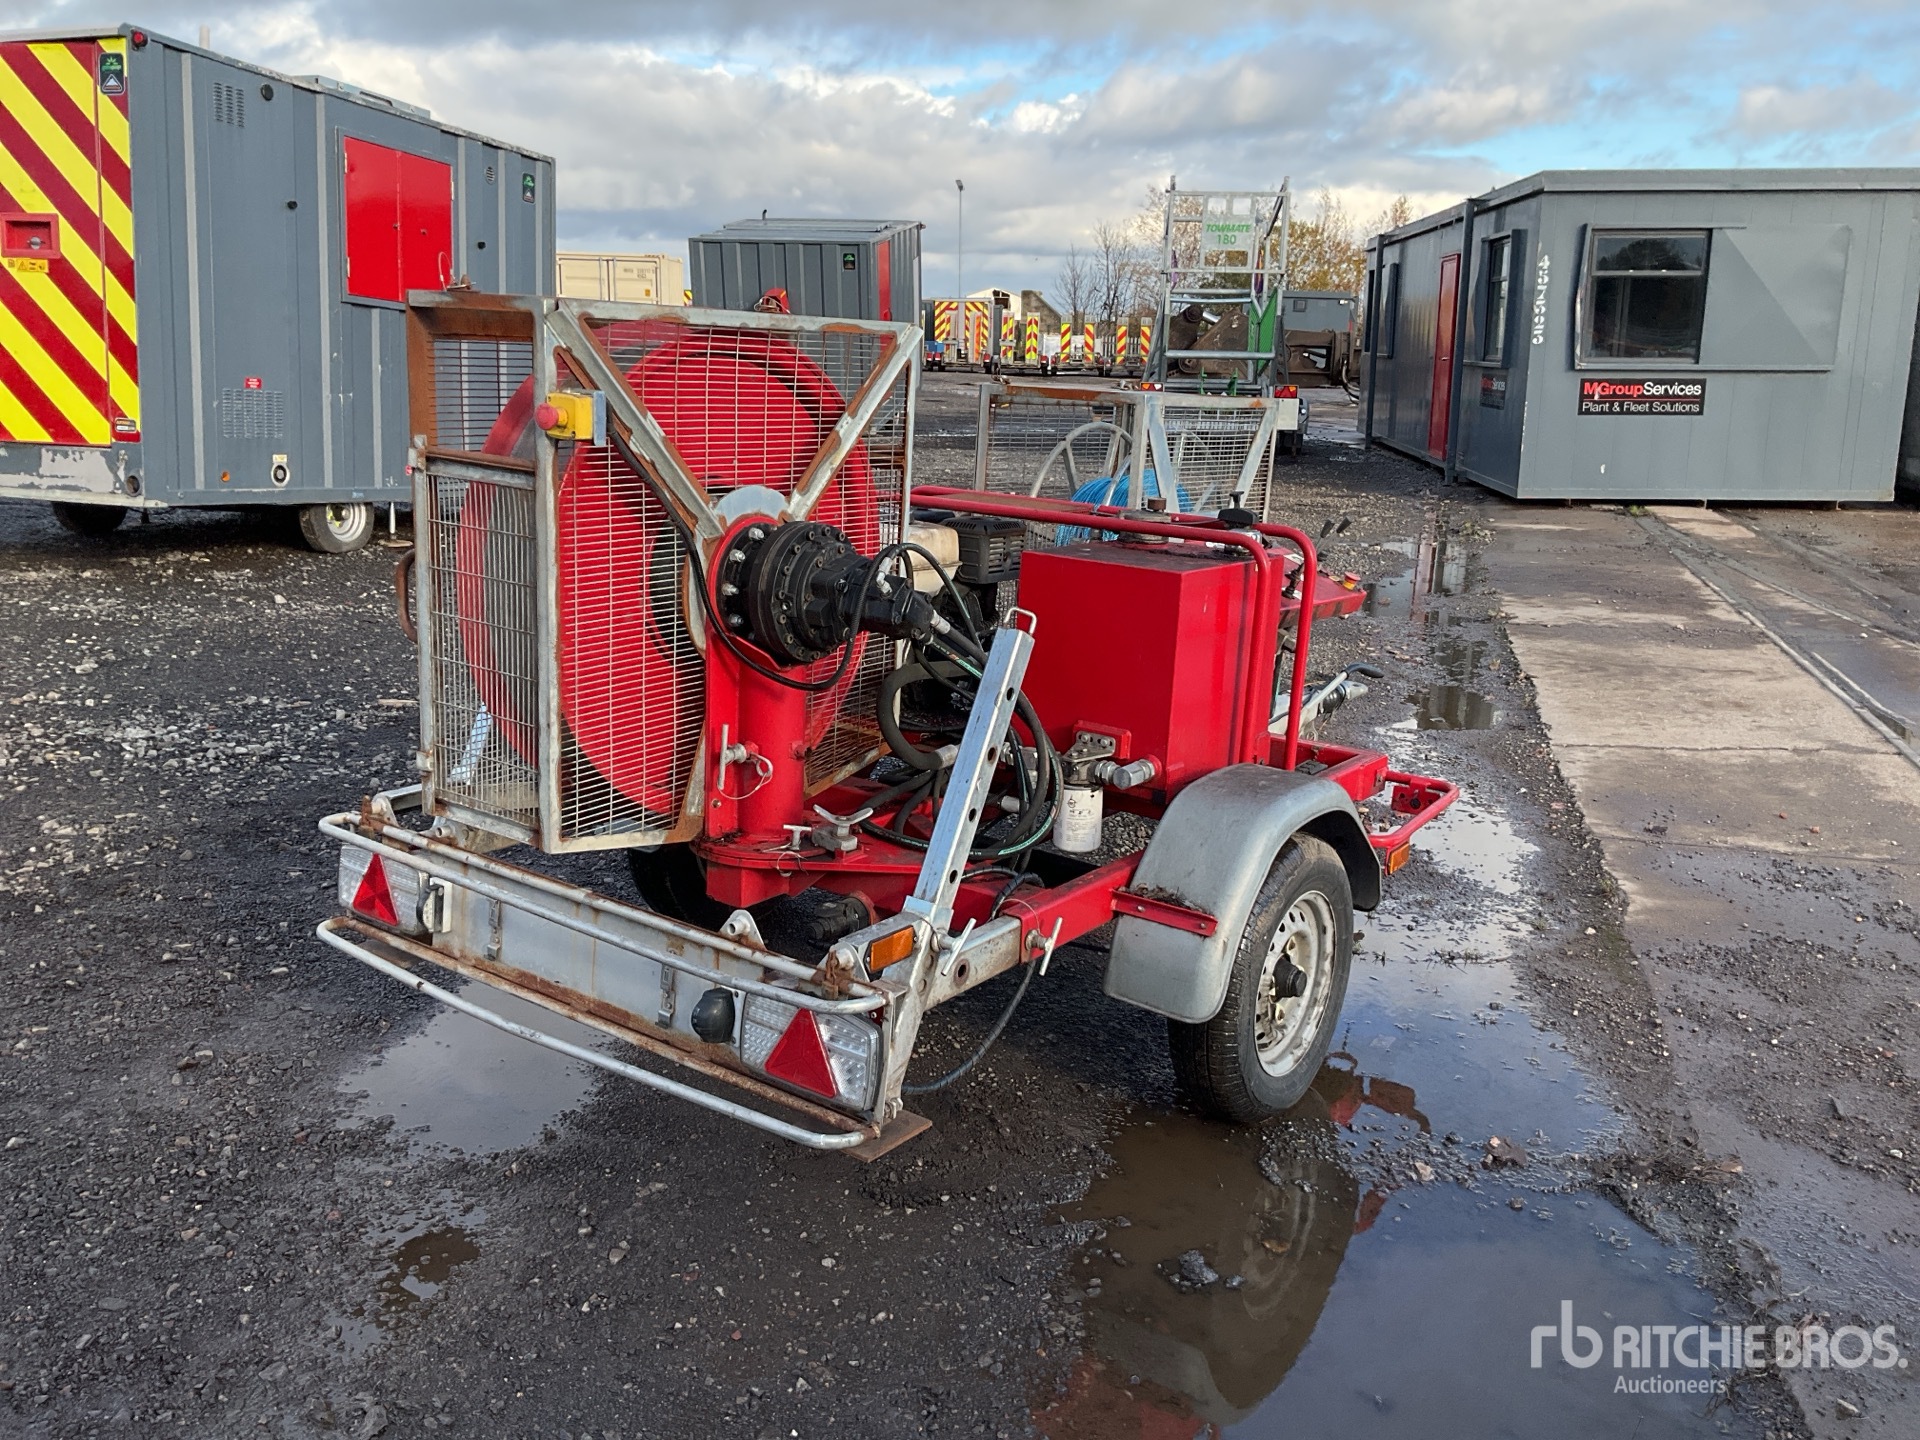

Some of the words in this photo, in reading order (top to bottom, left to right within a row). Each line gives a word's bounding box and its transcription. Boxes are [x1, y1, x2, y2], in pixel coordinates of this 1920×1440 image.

[1205, 223, 1251, 233] TOWMATE
[1217, 234, 1237, 245] 180
[1582, 401, 1609, 412] Plant
[1612, 402, 1620, 412] &
[1623, 401, 1649, 412] Fleet
[1652, 401, 1700, 412] Solutions
